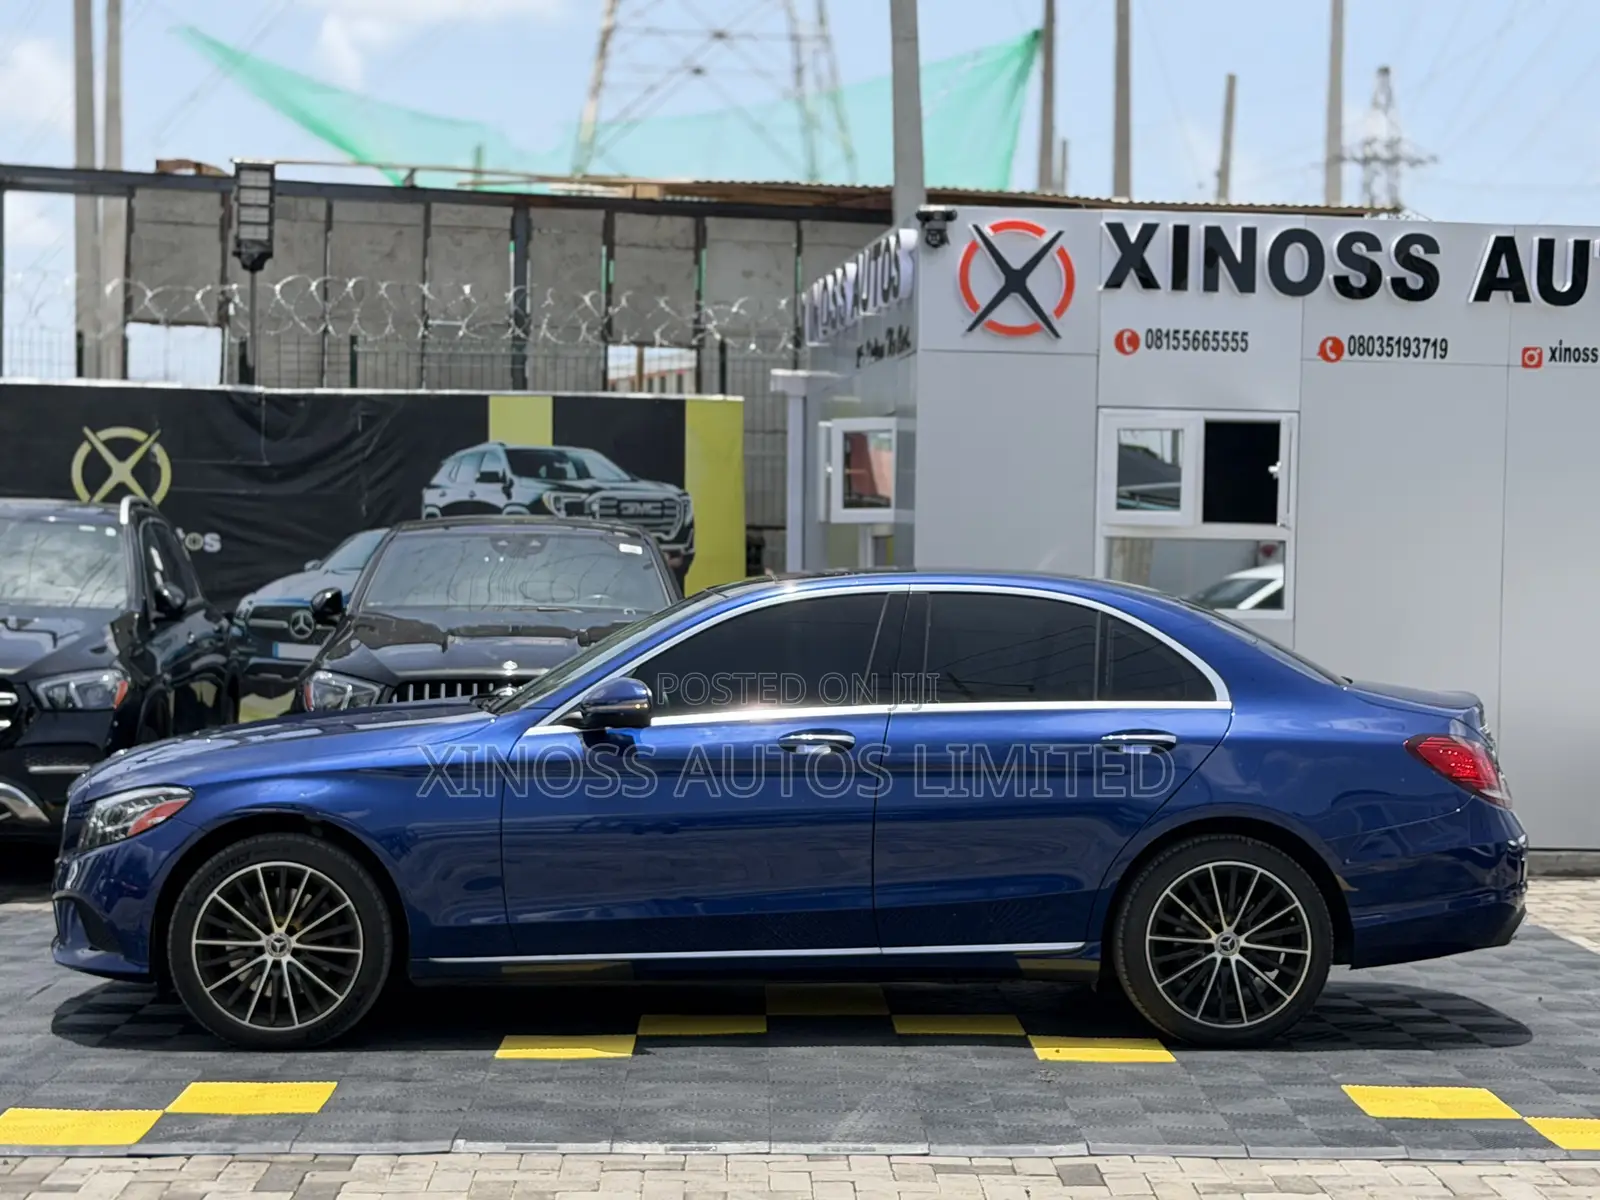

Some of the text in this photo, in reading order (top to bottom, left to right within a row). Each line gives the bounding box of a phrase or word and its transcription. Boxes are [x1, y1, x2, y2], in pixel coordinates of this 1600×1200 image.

[1100, 221, 1600, 307] XINOSS AU
[1145, 328, 1249, 353] 08155665555
[1347, 334, 1449, 360] 08035193719
[1548, 339, 1599, 364] xinoss
